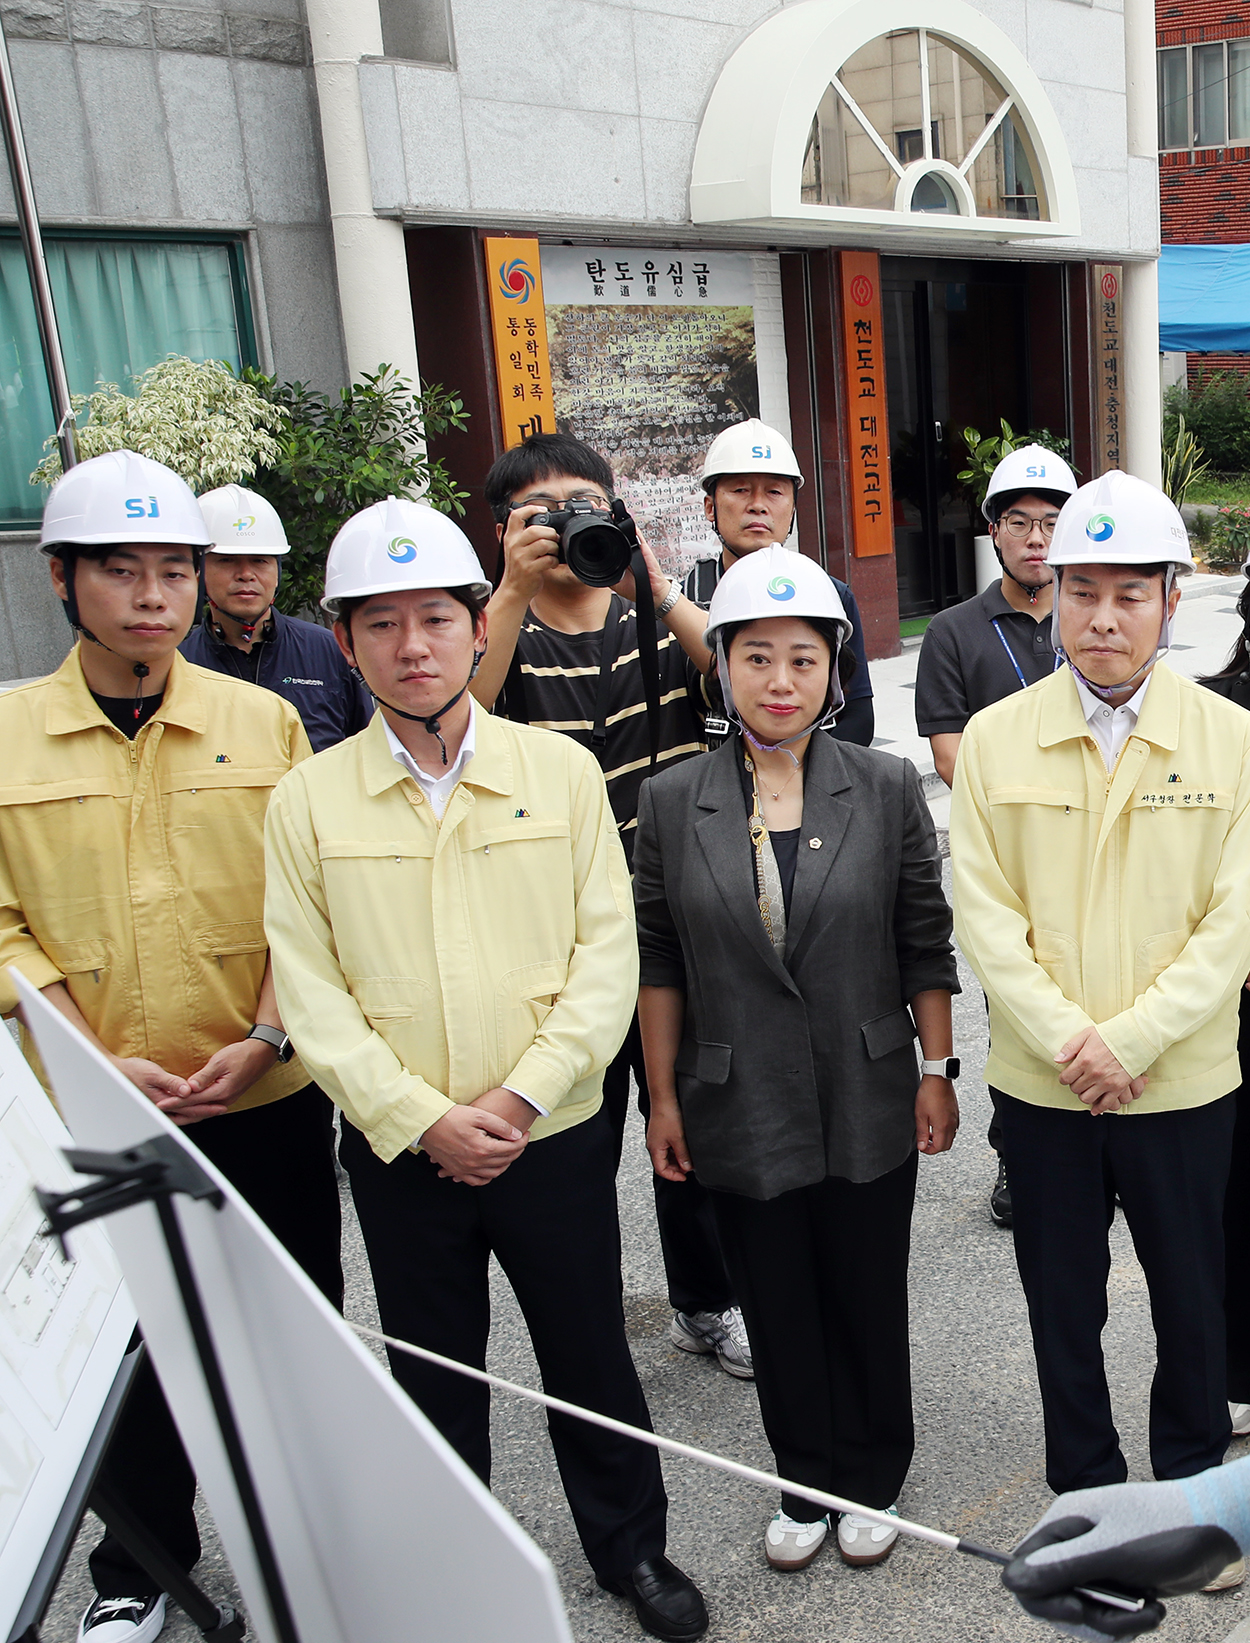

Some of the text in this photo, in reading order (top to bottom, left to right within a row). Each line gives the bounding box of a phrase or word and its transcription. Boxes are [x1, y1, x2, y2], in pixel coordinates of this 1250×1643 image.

[585, 258, 711, 286] 탄도유심급
[506, 317, 526, 401] 통일회
[523, 317, 545, 401] 동학민족
[1102, 301, 1121, 471] 천도교 대전·충청지역
[854, 318, 883, 523] 천도교 대전교구
